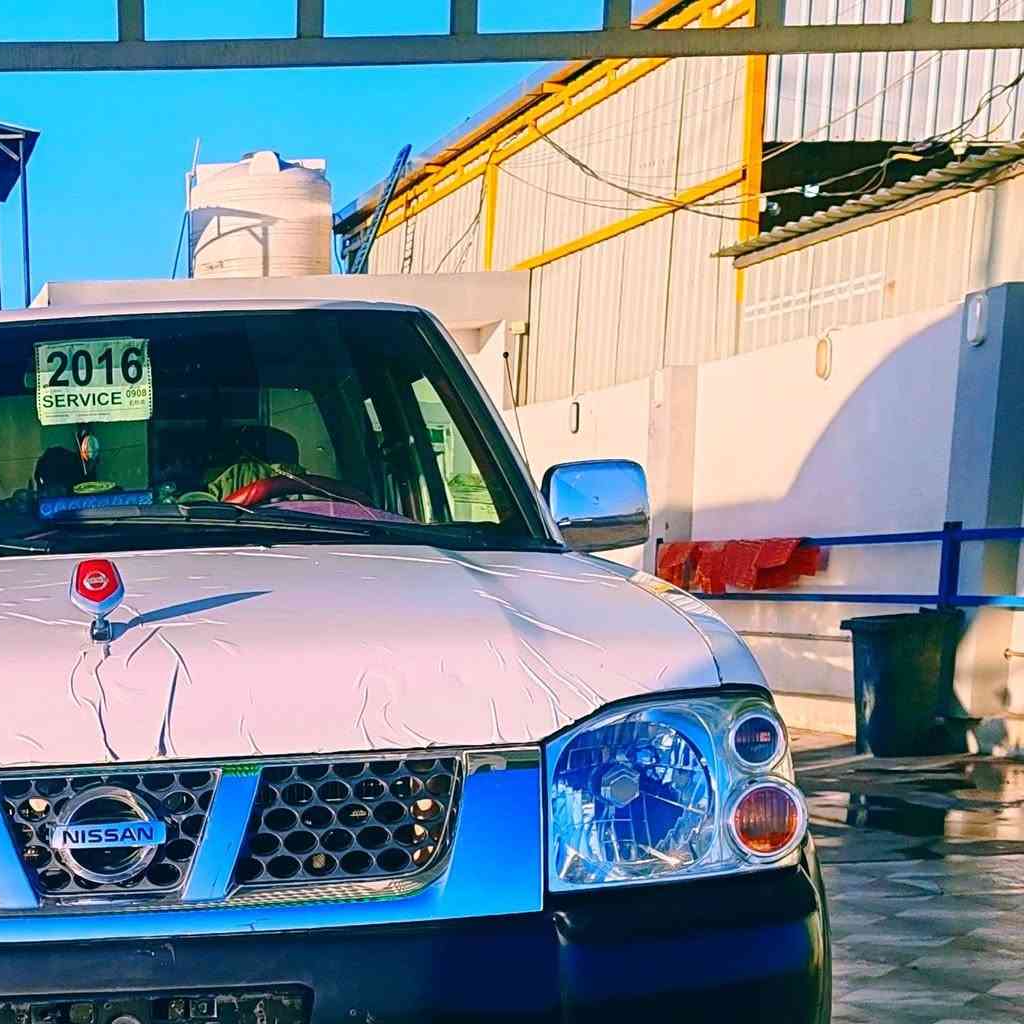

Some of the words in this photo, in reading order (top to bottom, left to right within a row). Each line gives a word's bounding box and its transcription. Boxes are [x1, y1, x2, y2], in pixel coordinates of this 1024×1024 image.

[46, 346, 144, 388] 2016
[42, 391, 122, 409] SERVICE
[62, 826, 155, 844] NISSAN
